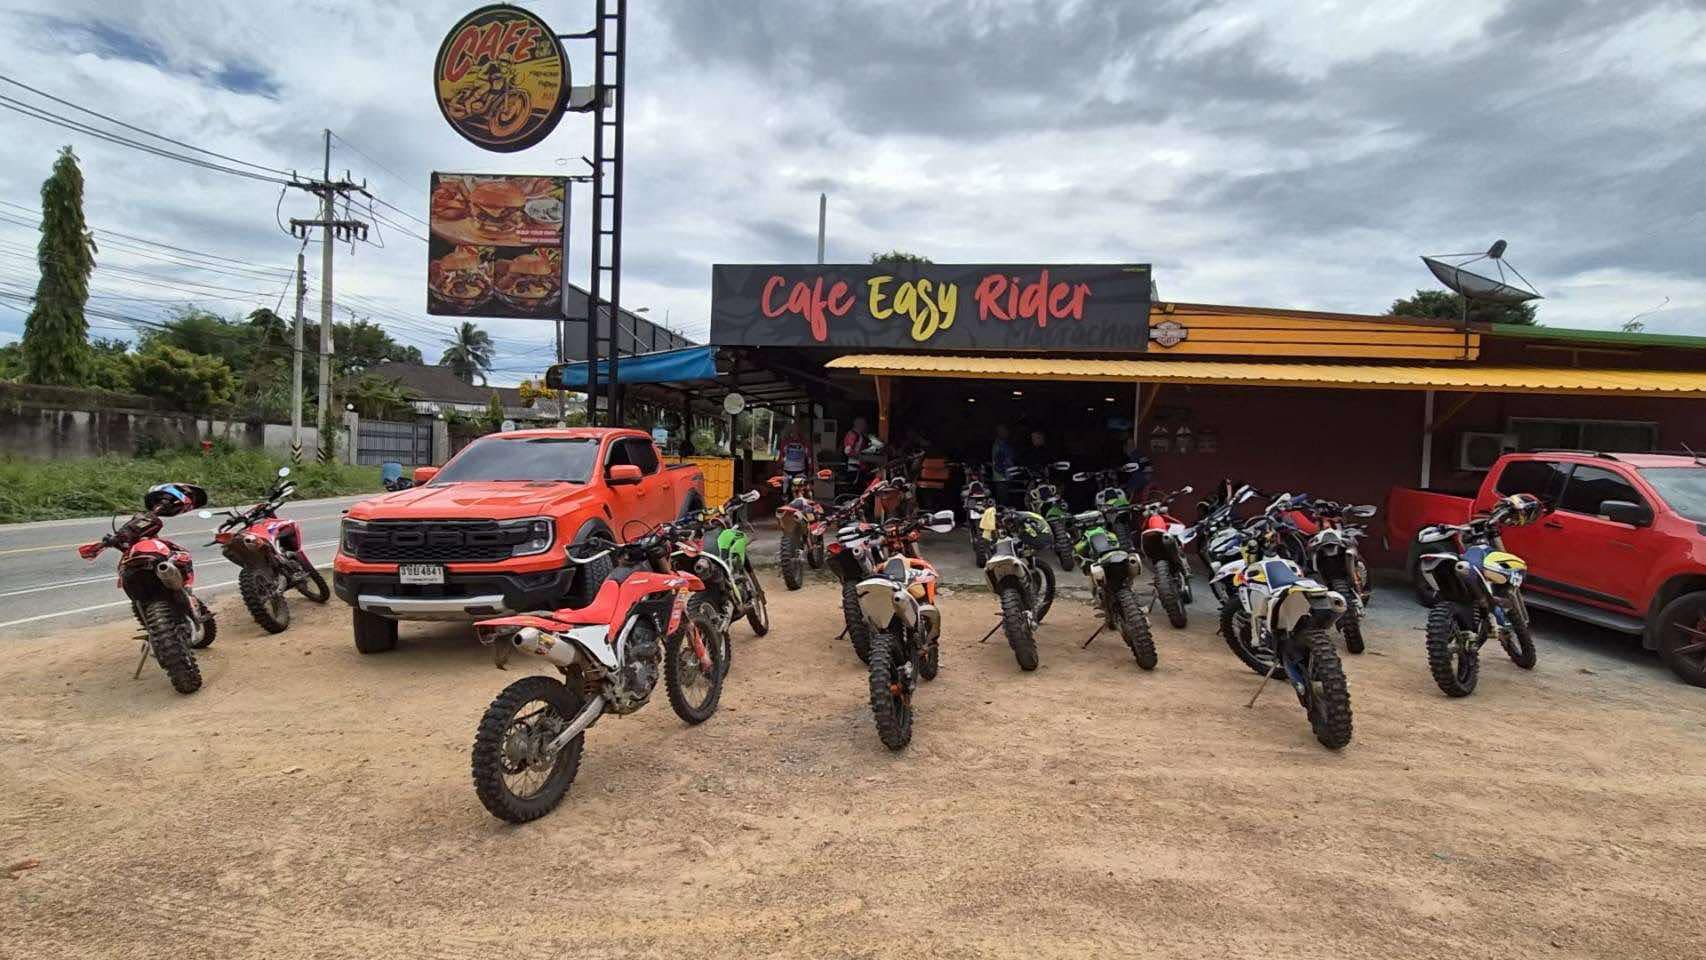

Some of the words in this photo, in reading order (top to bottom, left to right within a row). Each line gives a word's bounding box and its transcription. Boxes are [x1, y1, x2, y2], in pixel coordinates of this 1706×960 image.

[445, 20, 541, 82] CAFE
[762, 275, 856, 342] Cafe
[867, 275, 959, 342] Easy
[975, 269, 1092, 328] Rider
